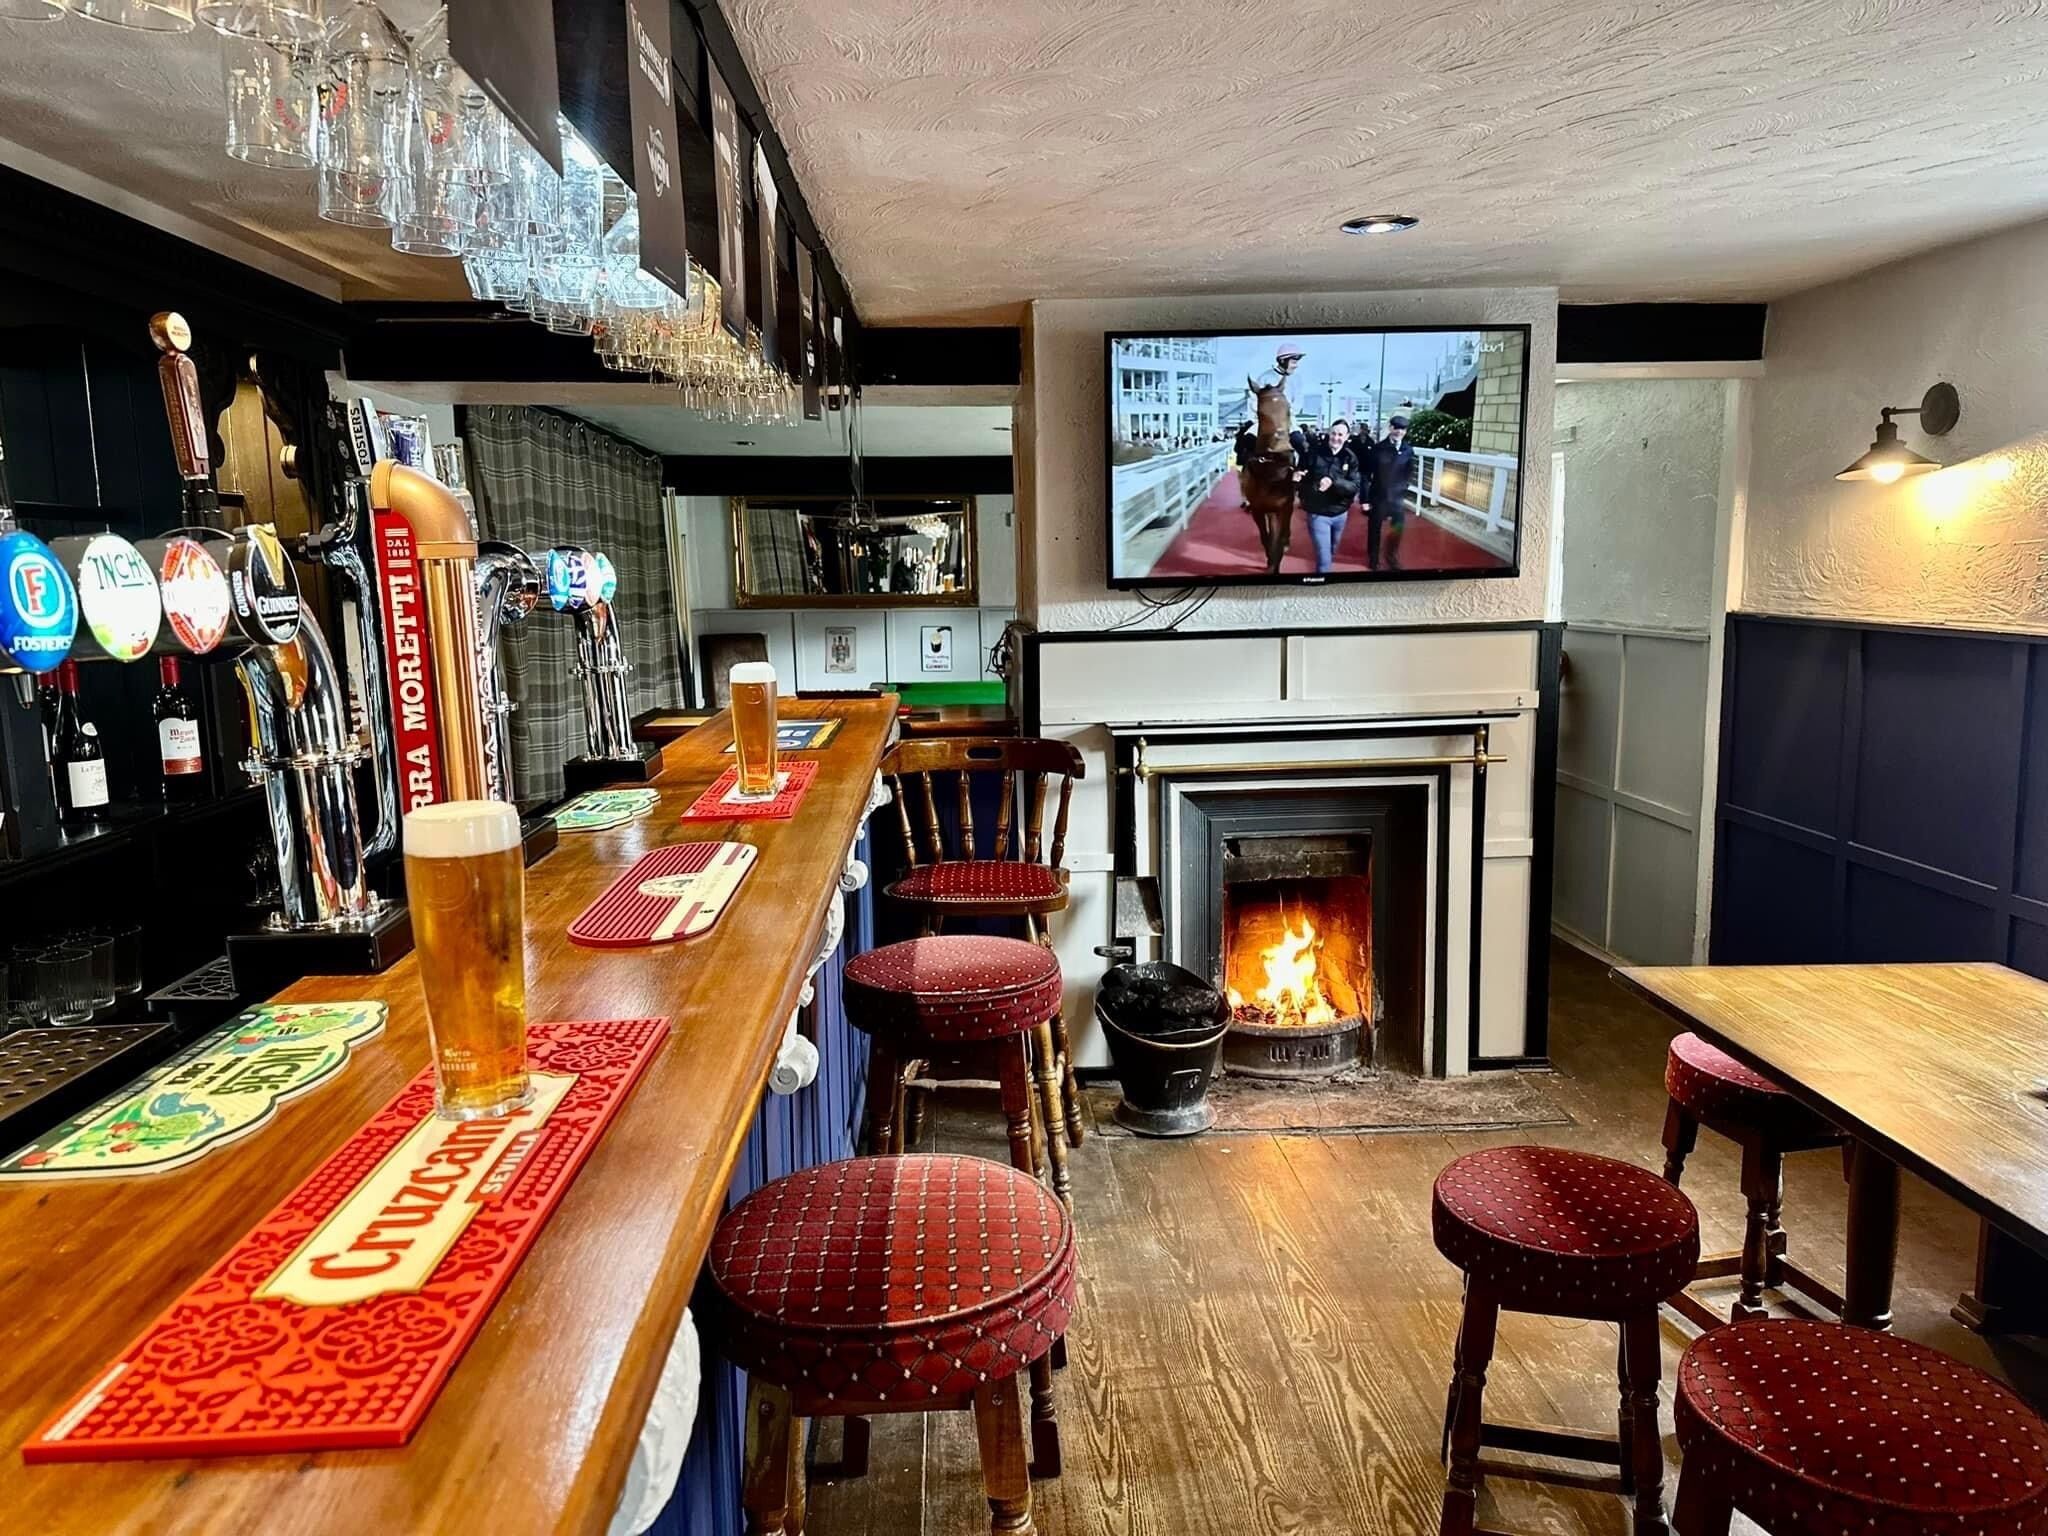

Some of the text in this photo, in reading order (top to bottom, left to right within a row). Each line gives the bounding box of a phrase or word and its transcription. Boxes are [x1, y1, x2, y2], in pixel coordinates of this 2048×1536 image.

[386, 539, 410, 548] DAL
[257, 595, 299, 615] GUINNESS
[388, 574, 435, 816] RRA MORETTI
[309, 1109, 533, 1279] Cruzcam
[480, 1132, 541, 1194] SEVILLA
